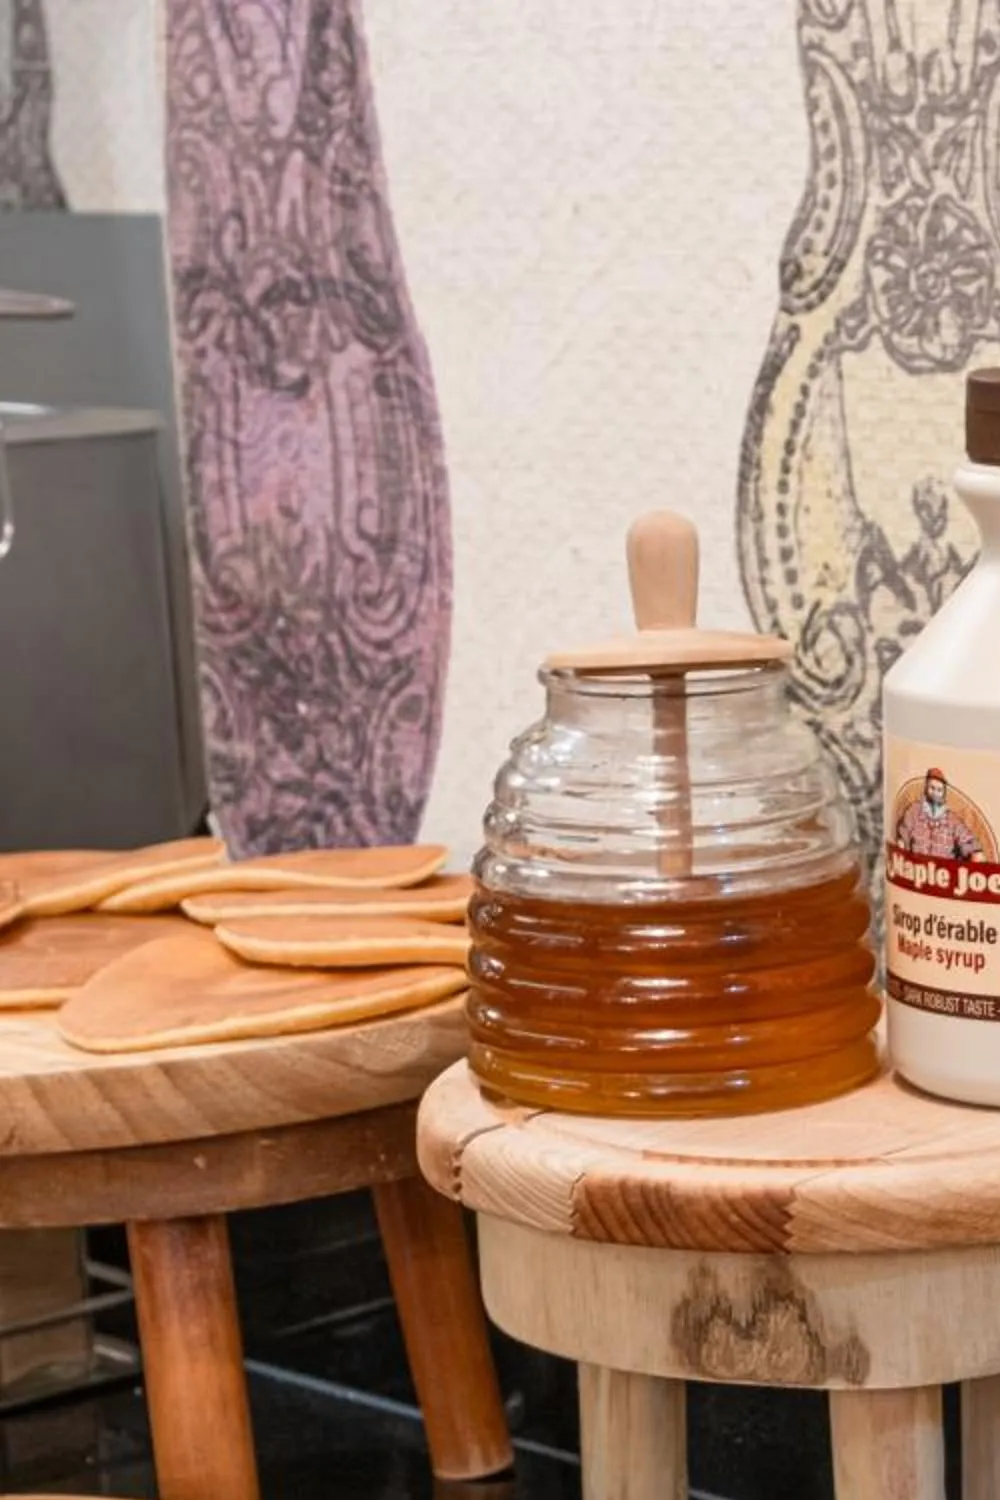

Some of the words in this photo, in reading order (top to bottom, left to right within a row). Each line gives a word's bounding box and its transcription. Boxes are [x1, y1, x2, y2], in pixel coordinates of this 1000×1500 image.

[889, 852, 950, 888] Maple
[893, 904, 921, 937] Sirop
[924, 914, 997, 945] d'érable
[898, 932, 933, 962] Maple
[936, 949, 985, 973] syrup
[963, 999, 995, 1017] TASTE
